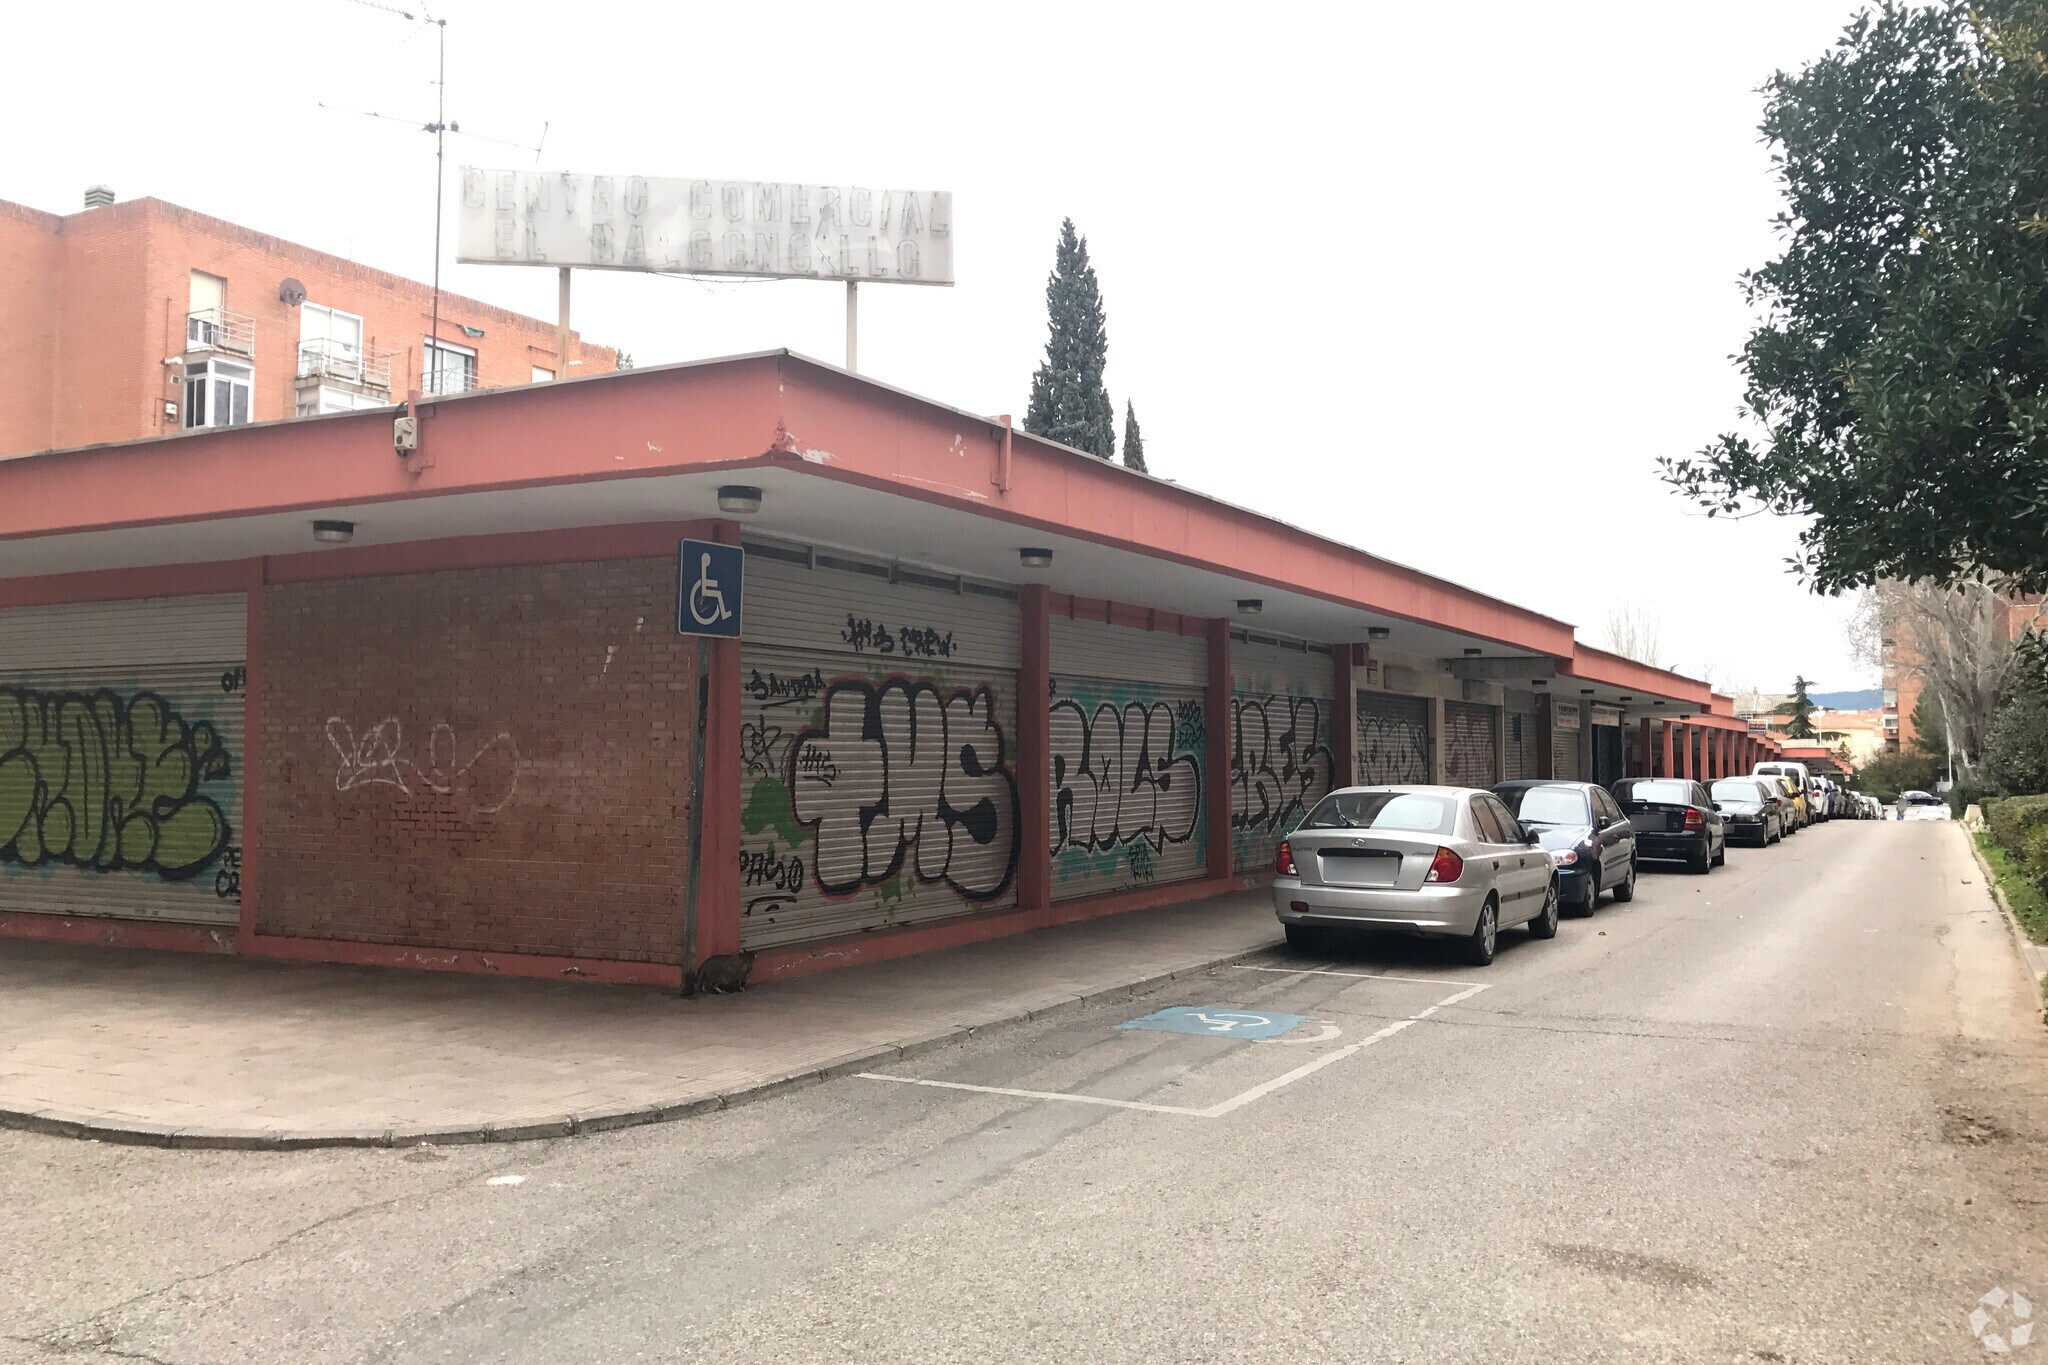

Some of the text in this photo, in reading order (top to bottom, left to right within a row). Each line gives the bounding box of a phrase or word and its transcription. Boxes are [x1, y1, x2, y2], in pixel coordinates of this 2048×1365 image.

[463, 167, 950, 234] CENTRO COMERCIAL
[496, 219, 921, 279] EL BACONCLLO
